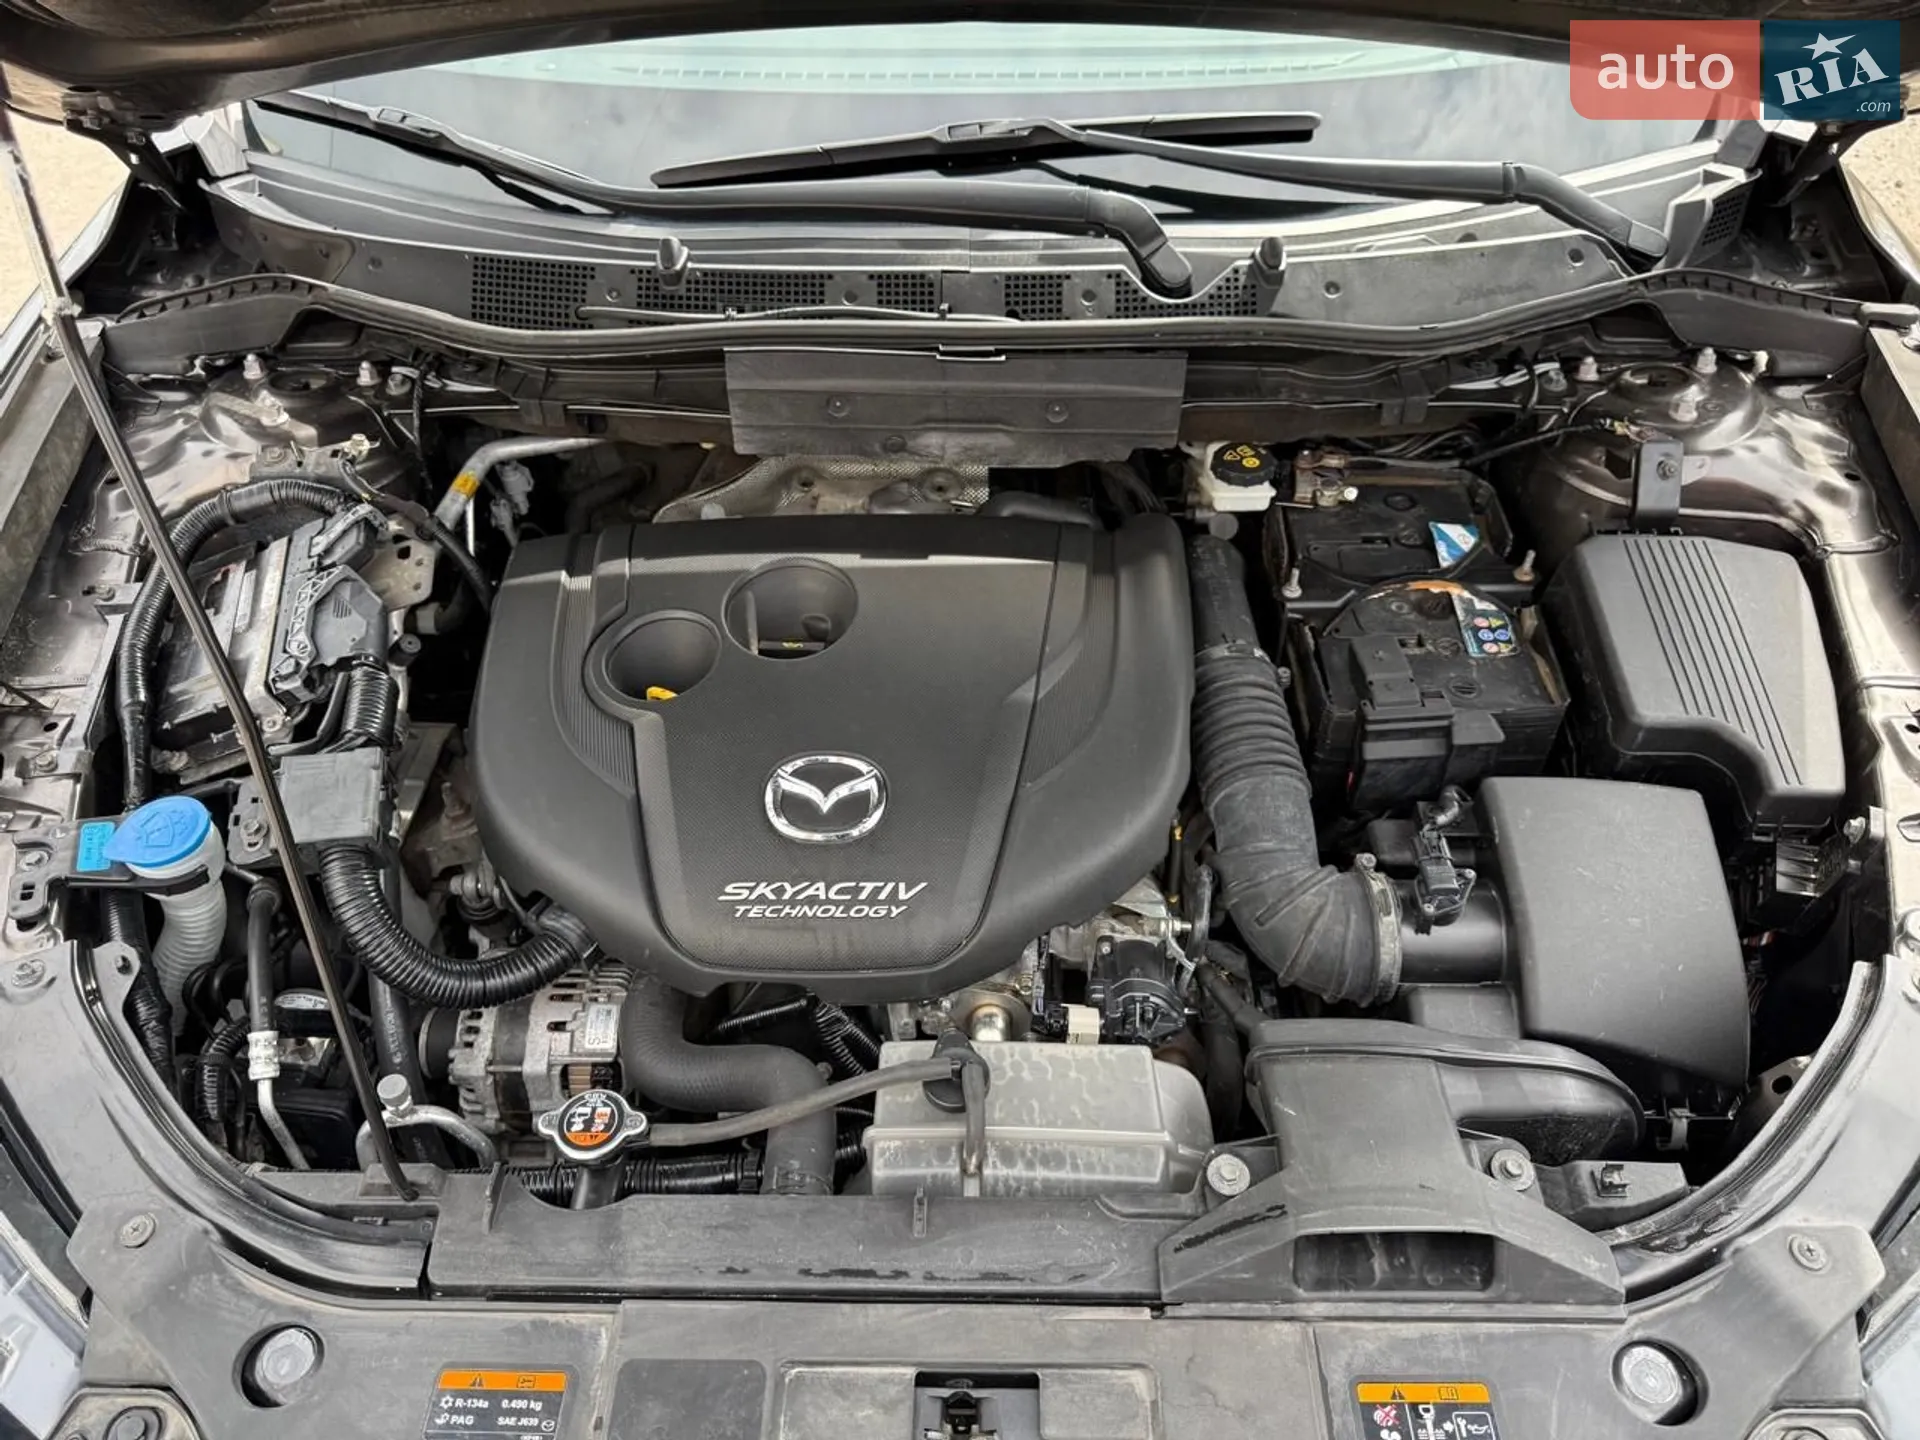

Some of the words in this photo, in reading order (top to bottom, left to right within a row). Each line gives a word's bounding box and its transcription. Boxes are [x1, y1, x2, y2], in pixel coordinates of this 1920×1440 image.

[717, 882, 928, 901] SKYACTIV
[734, 905, 908, 918] TECHNOLOGY
[454, 1398, 489, 1409] R-134a
[529, 1399, 543, 1412] kg
[450, 1415, 474, 1425] PAG
[497, 1416, 517, 1426] SAE
